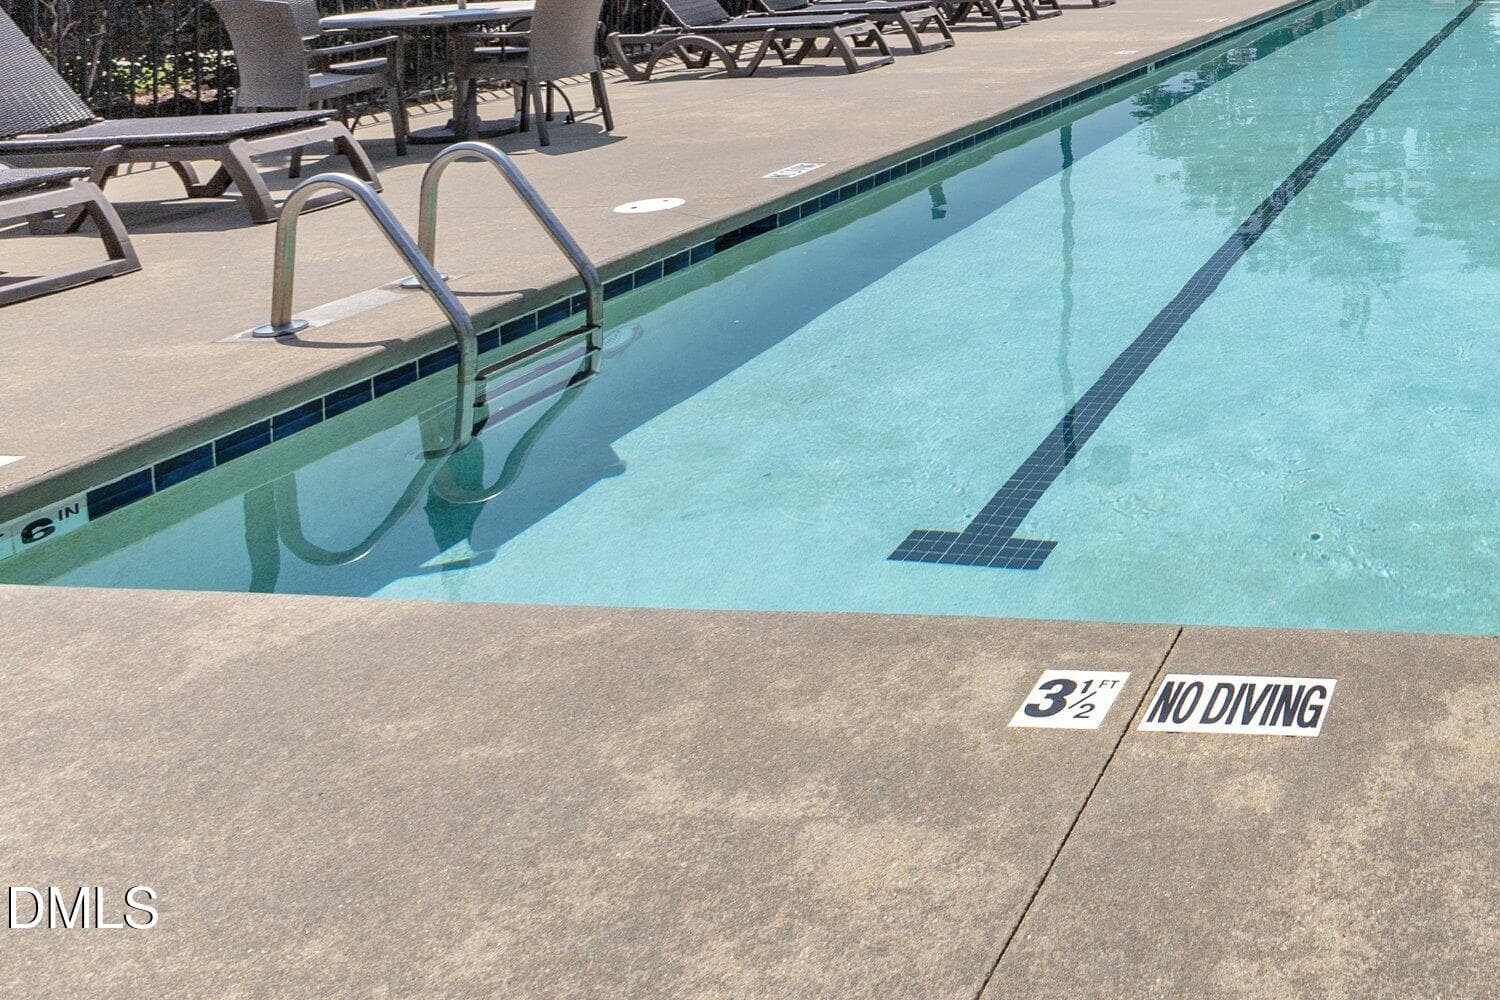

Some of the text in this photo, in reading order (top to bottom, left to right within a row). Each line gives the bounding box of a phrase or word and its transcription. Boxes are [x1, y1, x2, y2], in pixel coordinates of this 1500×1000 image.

[21, 503, 79, 544] 6 IN
[1099, 679, 1119, 689] FT
[1146, 681, 1327, 728] NO DIVING
